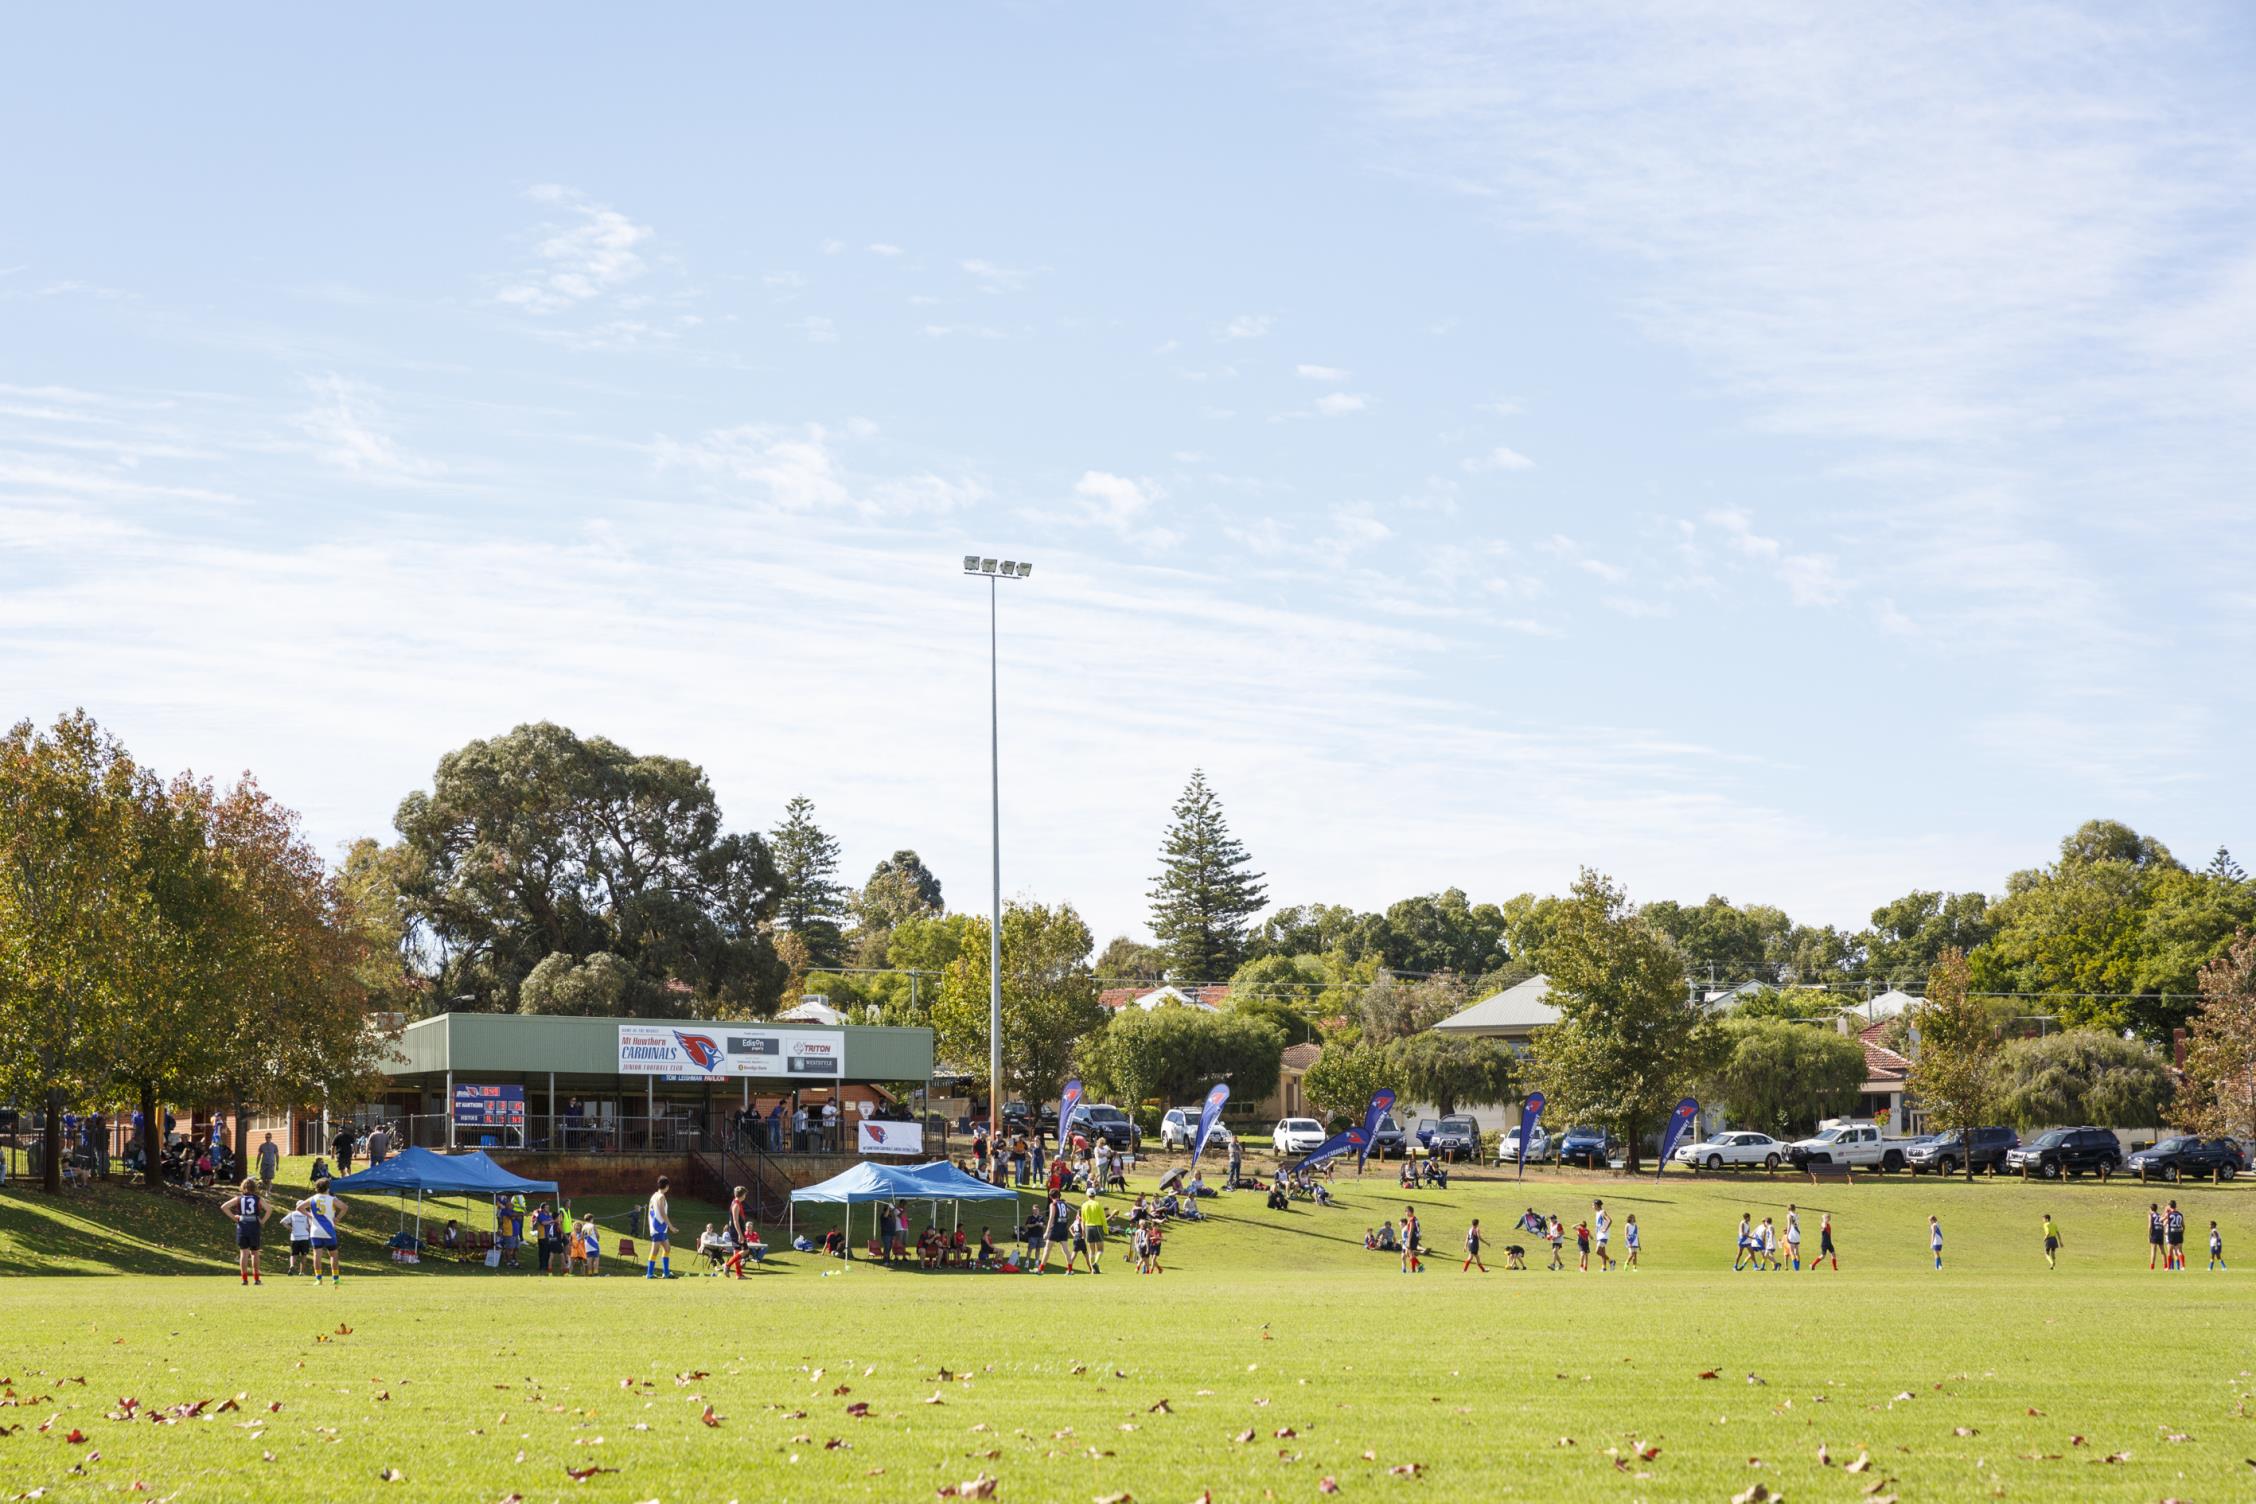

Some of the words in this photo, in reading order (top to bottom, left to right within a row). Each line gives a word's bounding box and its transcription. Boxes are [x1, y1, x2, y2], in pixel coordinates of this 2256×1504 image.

[621, 1036, 632, 1045] Mt
[632, 1037, 667, 1046] Hawthorn
[742, 1039, 765, 1047] Edison
[621, 1046, 677, 1060] CARDINALS
[804, 1044, 832, 1053] TRITON
[240, 1197, 256, 1215] 13
[316, 1199, 327, 1215] 5
[1057, 1203, 1067, 1218] 18
[2169, 1214, 2183, 1228] 20
